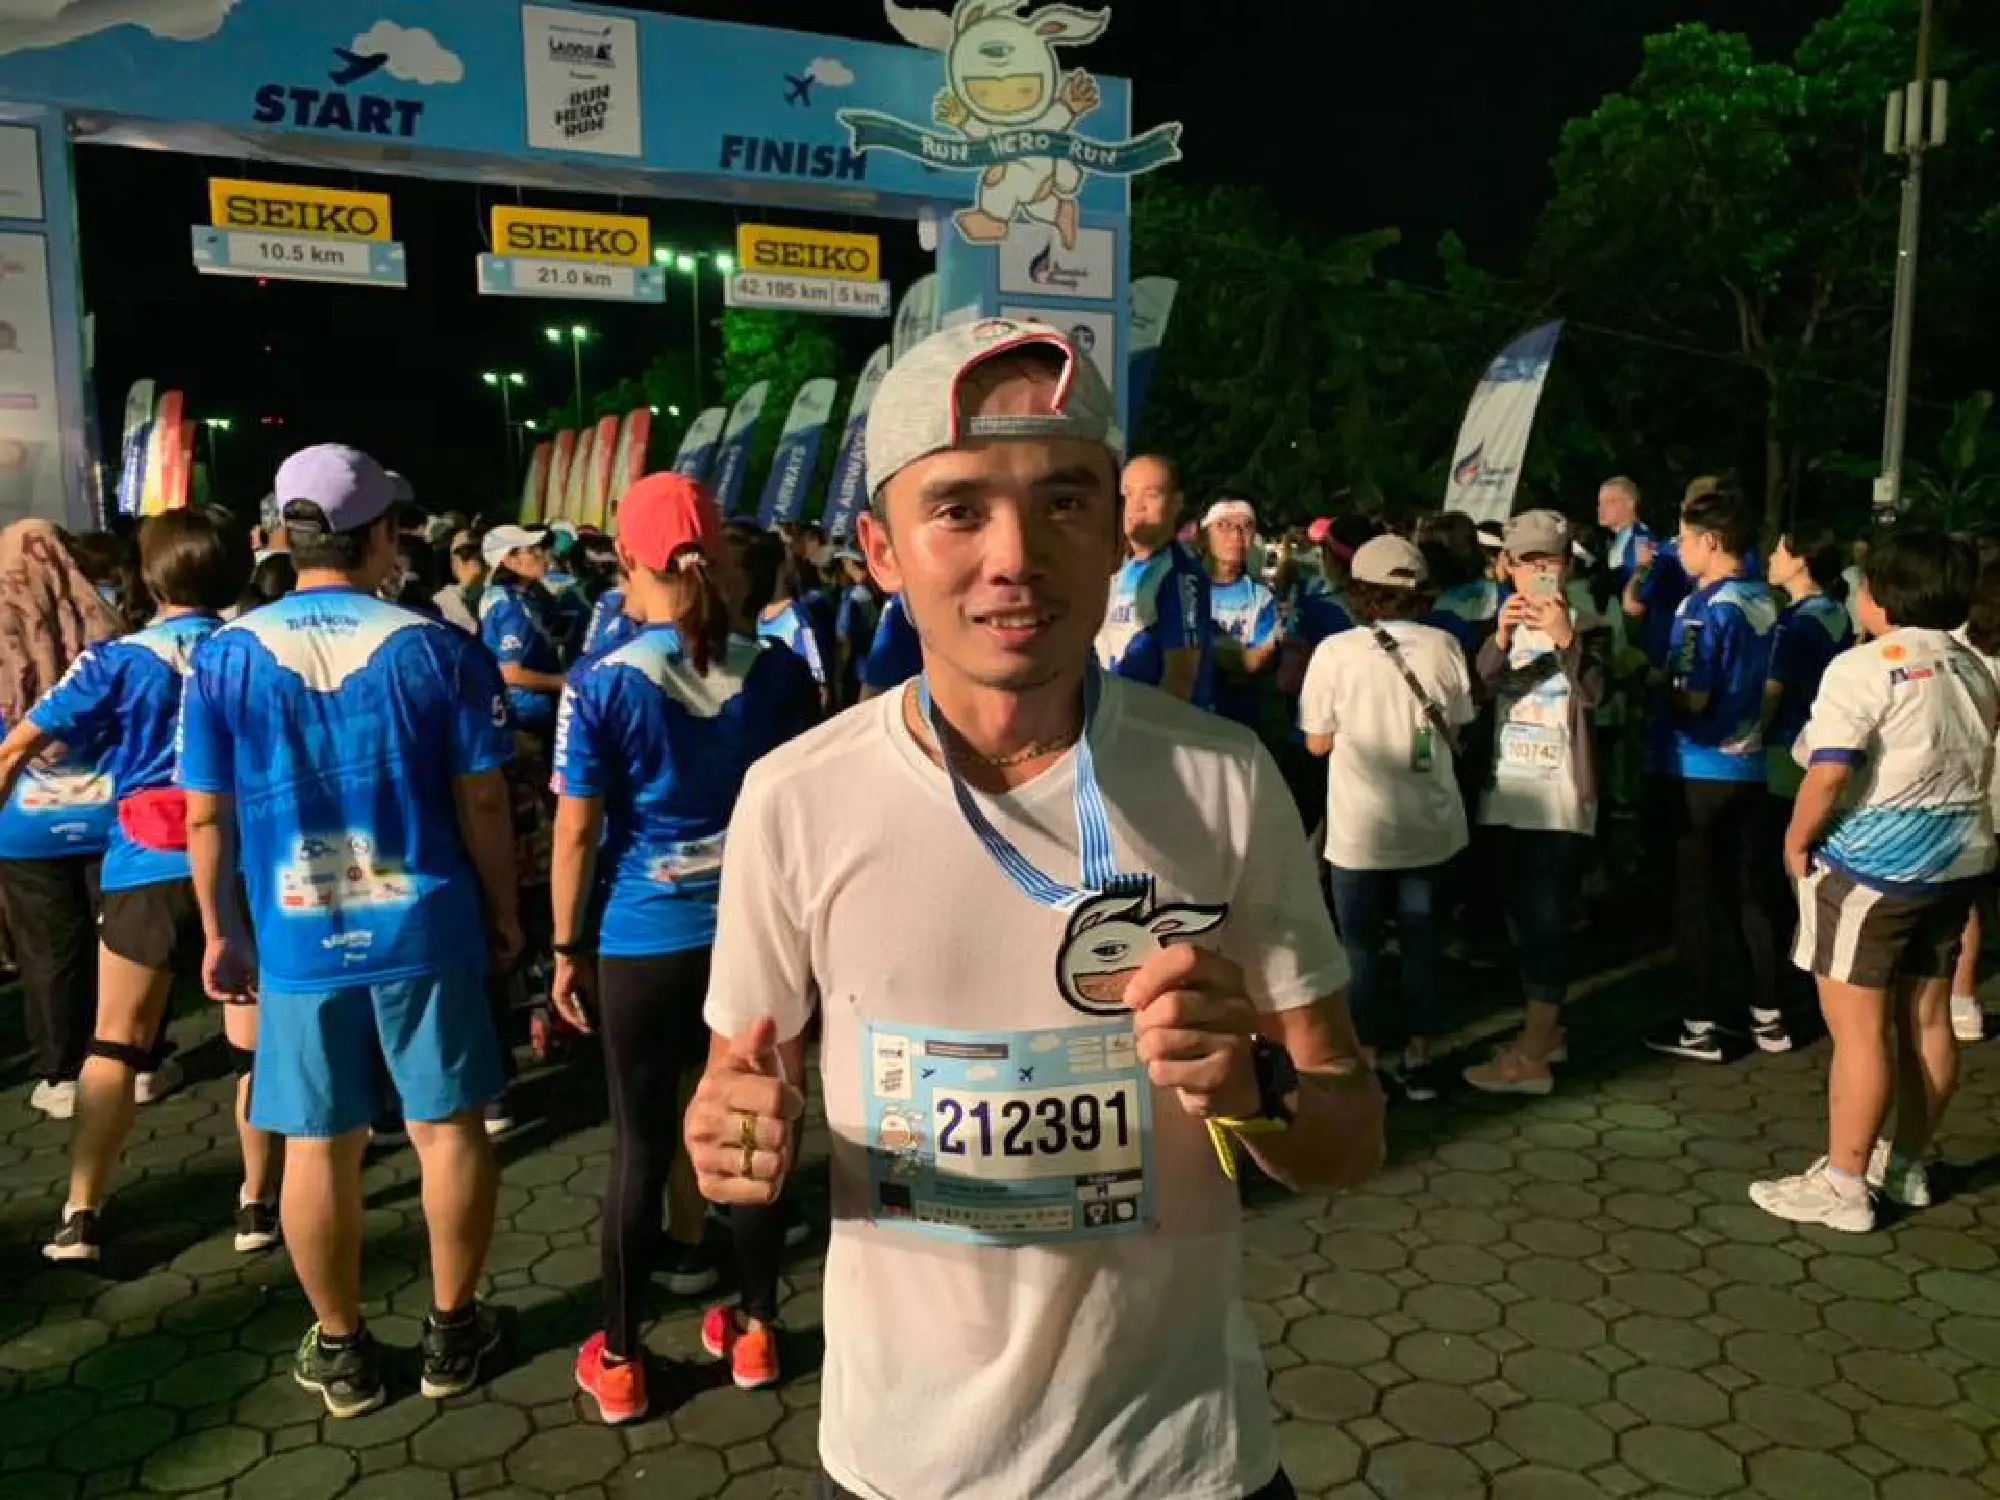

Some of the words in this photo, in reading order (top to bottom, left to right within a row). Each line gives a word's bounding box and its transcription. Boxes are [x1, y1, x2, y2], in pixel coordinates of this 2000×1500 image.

[254, 84, 424, 136] START
[720, 134, 867, 181] FINISH
[922, 136, 968, 161] RUN
[989, 132, 1051, 156] HERO
[1069, 140, 1117, 164] RUN
[227, 195, 379, 236] SEIKO
[259, 241, 304, 261] 10.5
[311, 246, 345, 265] km
[507, 221, 639, 257] SEIKO
[754, 239, 870, 273] SEIKO
[537, 266, 578, 285] 21.0
[583, 269, 612, 288] km
[801, 282, 828, 301] km
[853, 285, 880, 304] km
[936, 1090, 1128, 1156] 212391
